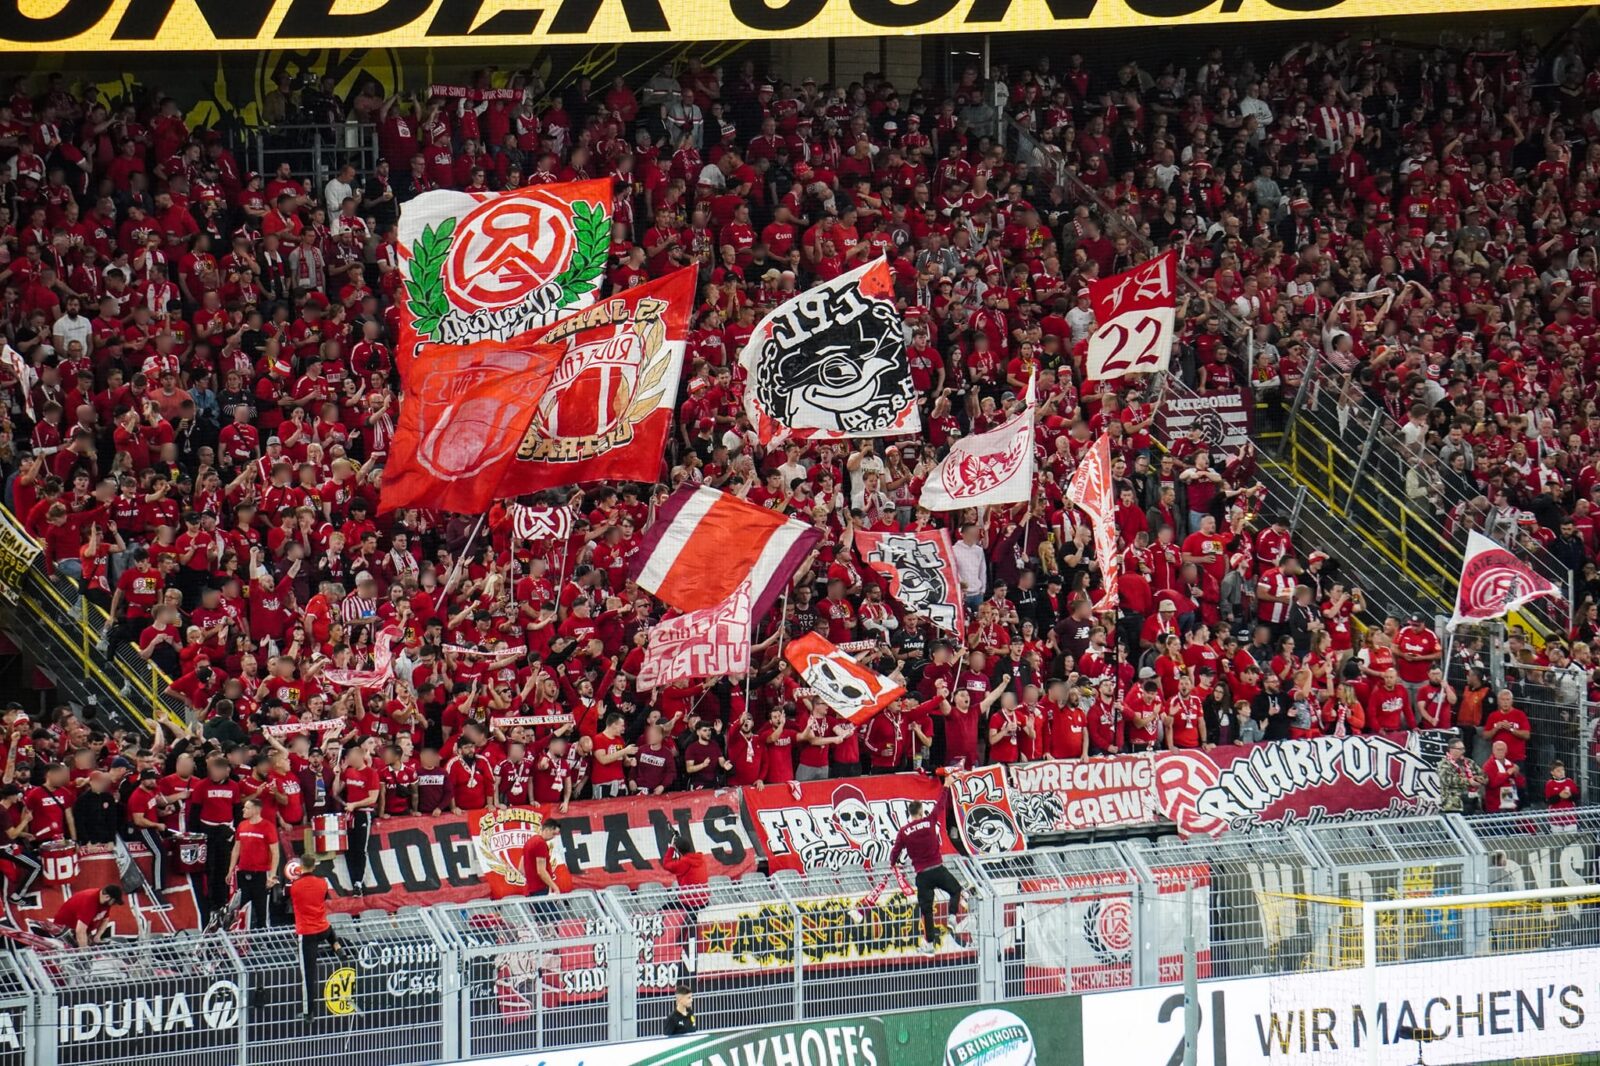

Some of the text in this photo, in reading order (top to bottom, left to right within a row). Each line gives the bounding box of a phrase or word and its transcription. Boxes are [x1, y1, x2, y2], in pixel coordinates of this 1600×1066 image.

[433, 85, 466, 97] WIR SIND
[482, 89, 514, 99] WIR SIND
[1098, 315, 1162, 375] 22
[955, 773, 1003, 804] LPL
[1018, 760, 1151, 793] WRECKING
[480, 808, 544, 830] 15 JAHRE
[1068, 789, 1145, 827] CREW
[493, 834, 514, 847] RUDE
[560, 804, 747, 876] FANS
[59, 992, 194, 1043] IDUNA
[1254, 1008, 1338, 1057] WIR
